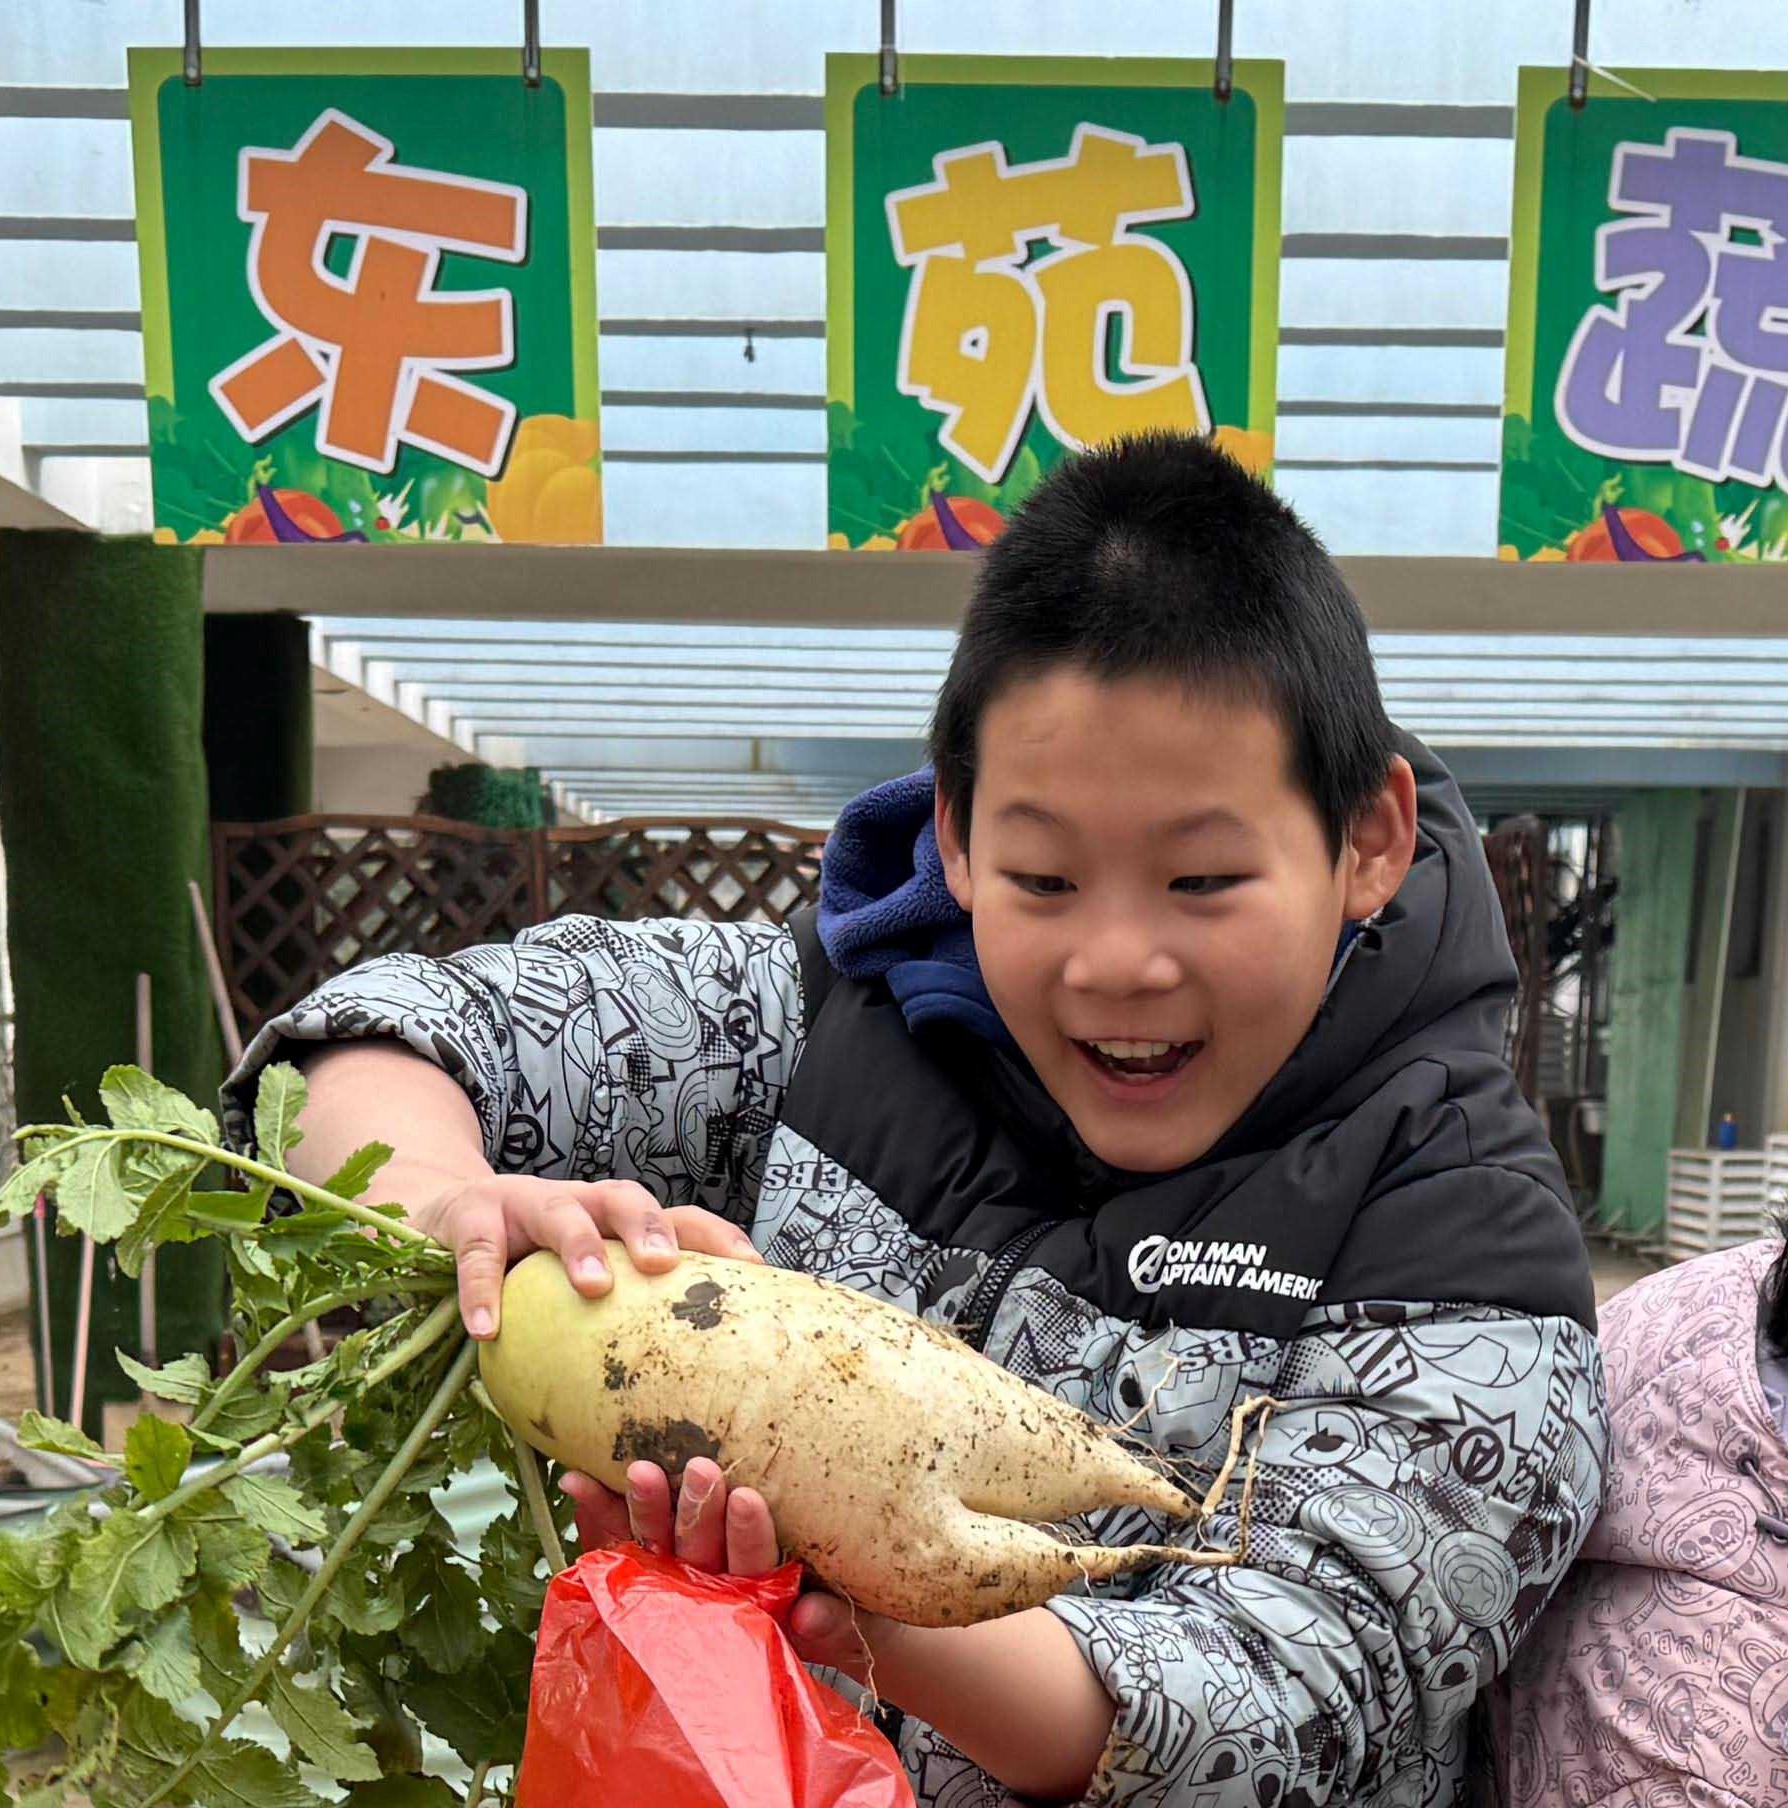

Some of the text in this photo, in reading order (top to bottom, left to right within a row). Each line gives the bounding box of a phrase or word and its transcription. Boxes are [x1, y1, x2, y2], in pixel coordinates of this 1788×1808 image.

[211, 108, 530, 478] 东
[888, 122, 1211, 484] 苑
[1204, 1241, 1267, 1267] MAN
